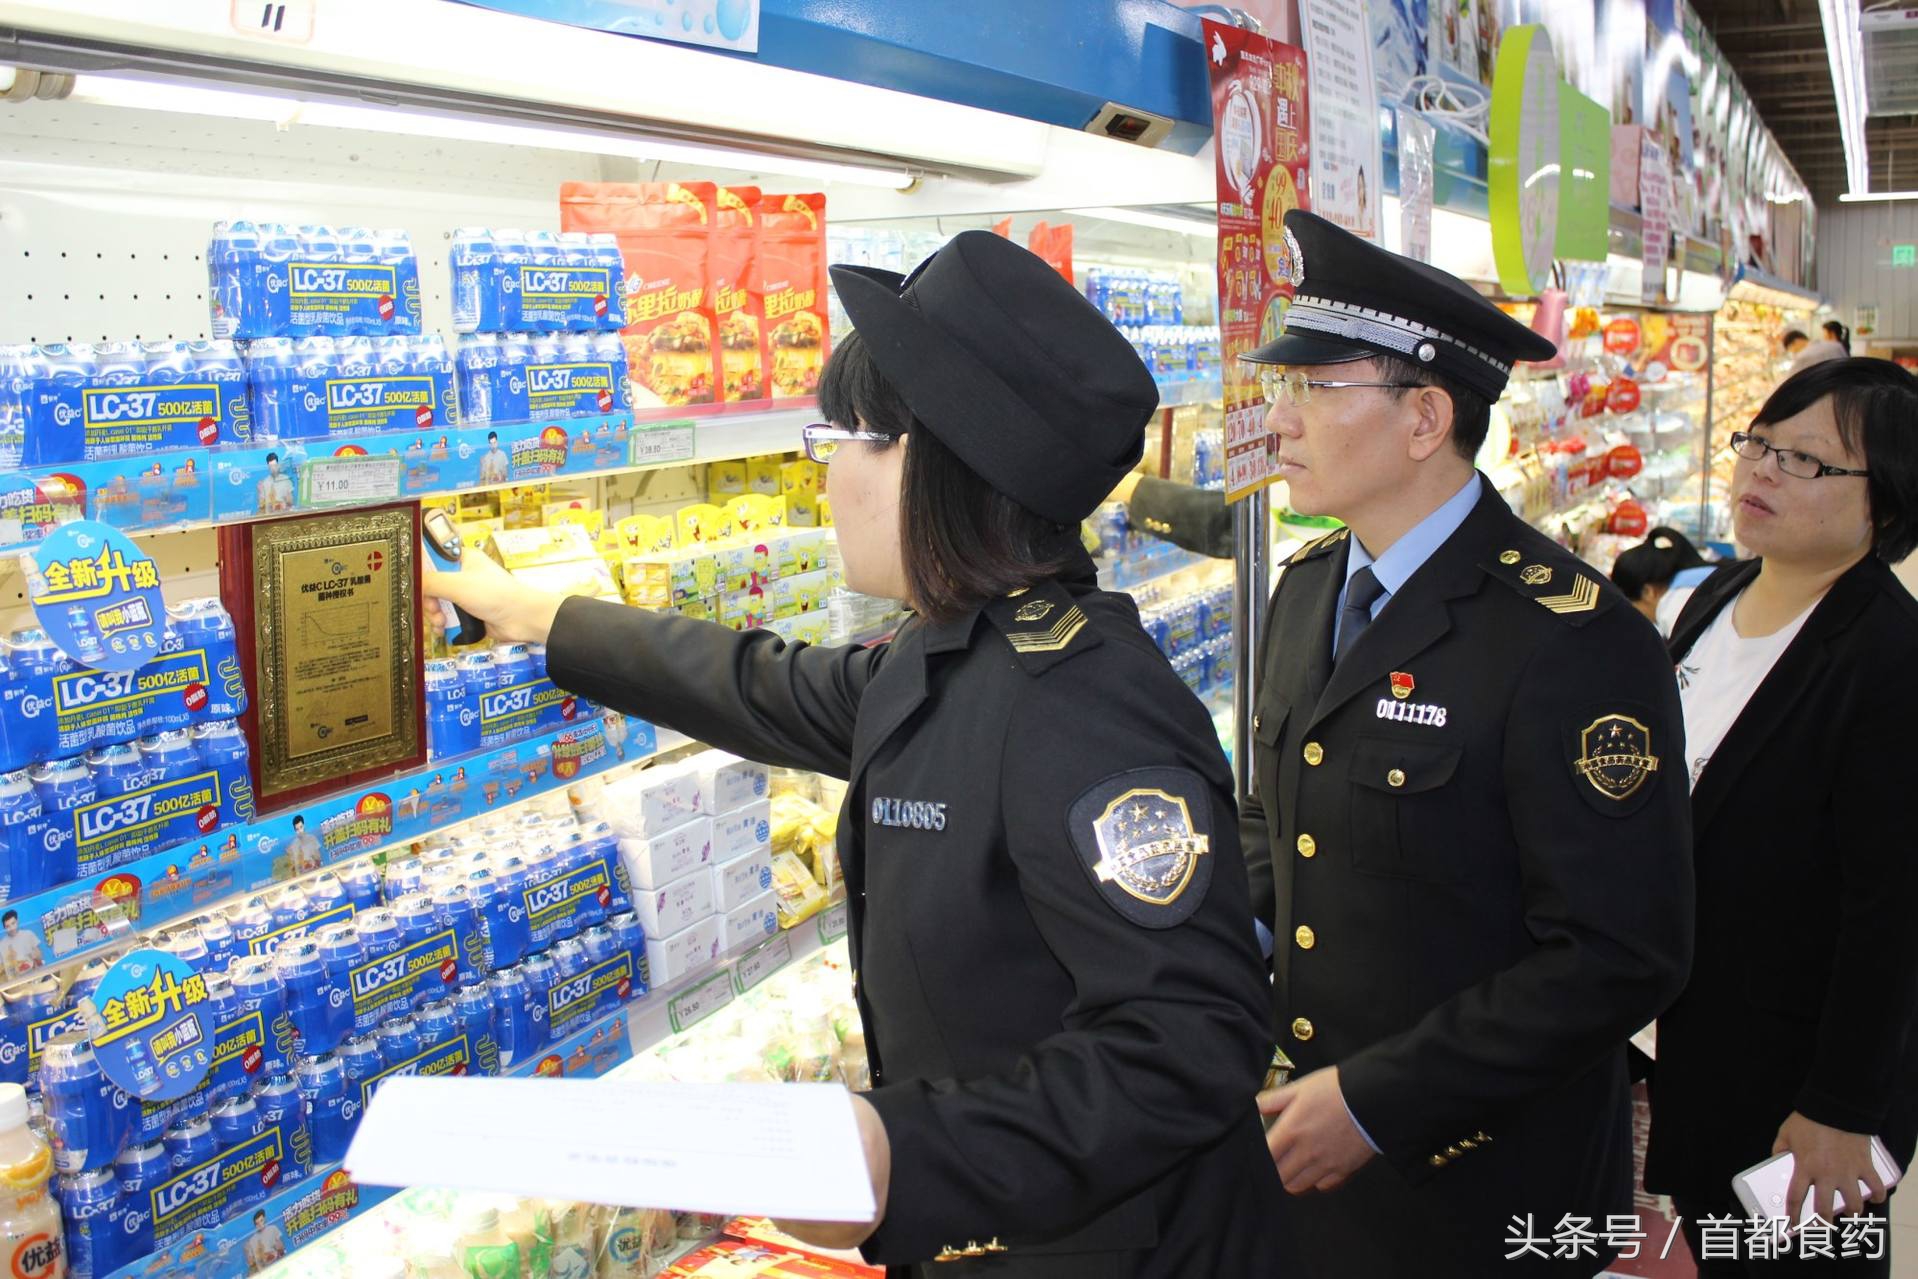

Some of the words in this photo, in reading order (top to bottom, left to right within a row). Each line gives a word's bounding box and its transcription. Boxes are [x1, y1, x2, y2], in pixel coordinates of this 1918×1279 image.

[294, 269, 346, 292] LC-37
[525, 272, 569, 292] LC-37
[531, 369, 571, 391] LC-37
[89, 393, 157, 421] LC-37
[158, 400, 213, 417] 500亿活菌
[332, 383, 383, 408] LC-37
[384, 391, 429, 404] 500亿活菌
[44, 541, 160, 592] 全新升级
[324, 577, 348, 591] LC-37
[61, 669, 135, 707] LC-37
[138, 667, 200, 691] 500亿活菌
[484, 688, 533, 719] LC-37
[1376, 698, 1447, 727] 0111178
[82, 794, 152, 839] LC-37
[153, 788, 212, 816] 500亿活菌
[872, 797, 948, 832] 0110805
[528, 879, 571, 912] LC-37
[408, 945, 452, 971] 500亿活菌
[356, 953, 407, 994] LC-37
[102, 964, 208, 1029] 全新升级
[552, 975, 593, 1010] LC-37
[222, 1144, 276, 1181] 500亿活菌
[158, 1162, 221, 1216] LC-37
